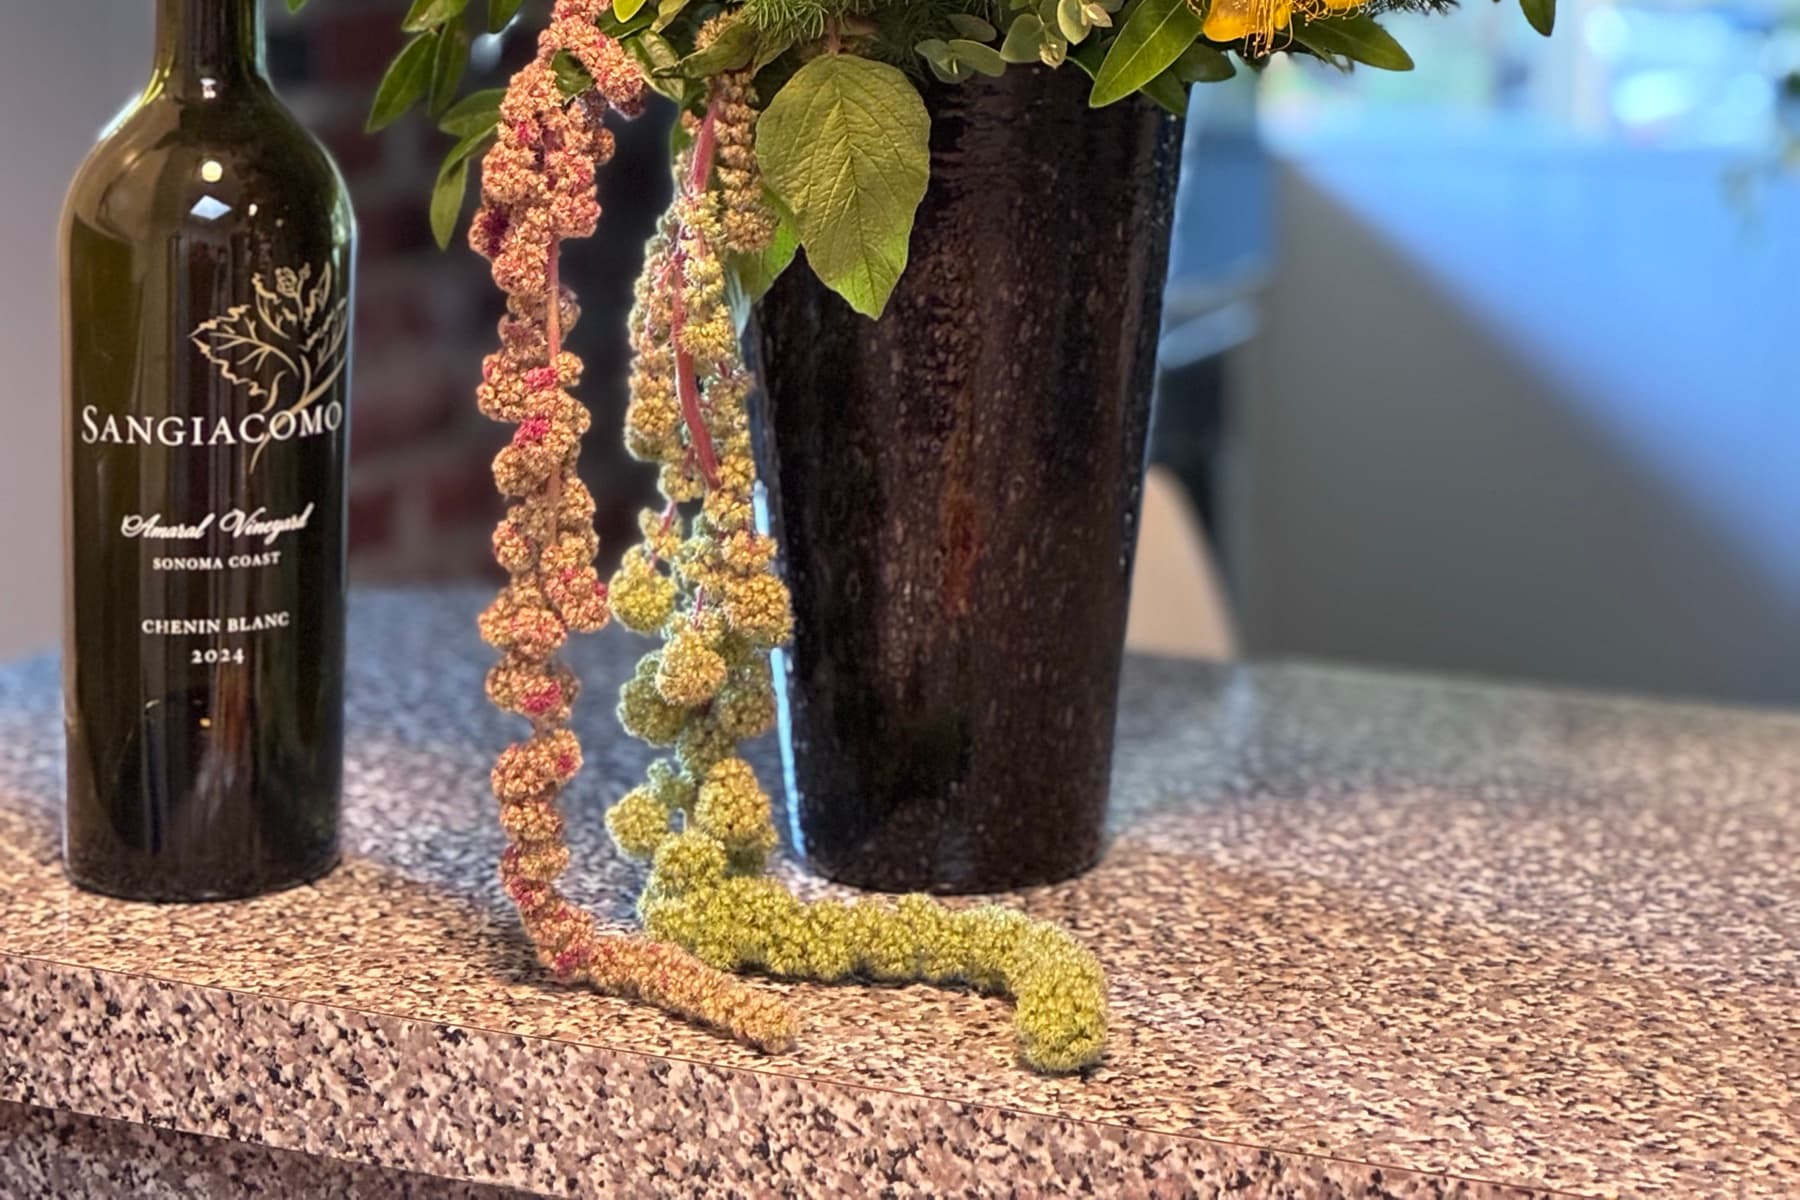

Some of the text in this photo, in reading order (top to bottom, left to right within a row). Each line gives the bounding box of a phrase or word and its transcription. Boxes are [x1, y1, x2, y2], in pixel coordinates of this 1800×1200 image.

[81, 401, 342, 446] SANGIACOMO
[121, 502, 315, 545] Amaral Vineyard
[152, 551, 281, 570] SONOMA COAST
[141, 611, 290, 635] CHENIN BLANC
[190, 648, 245, 664] 2024
